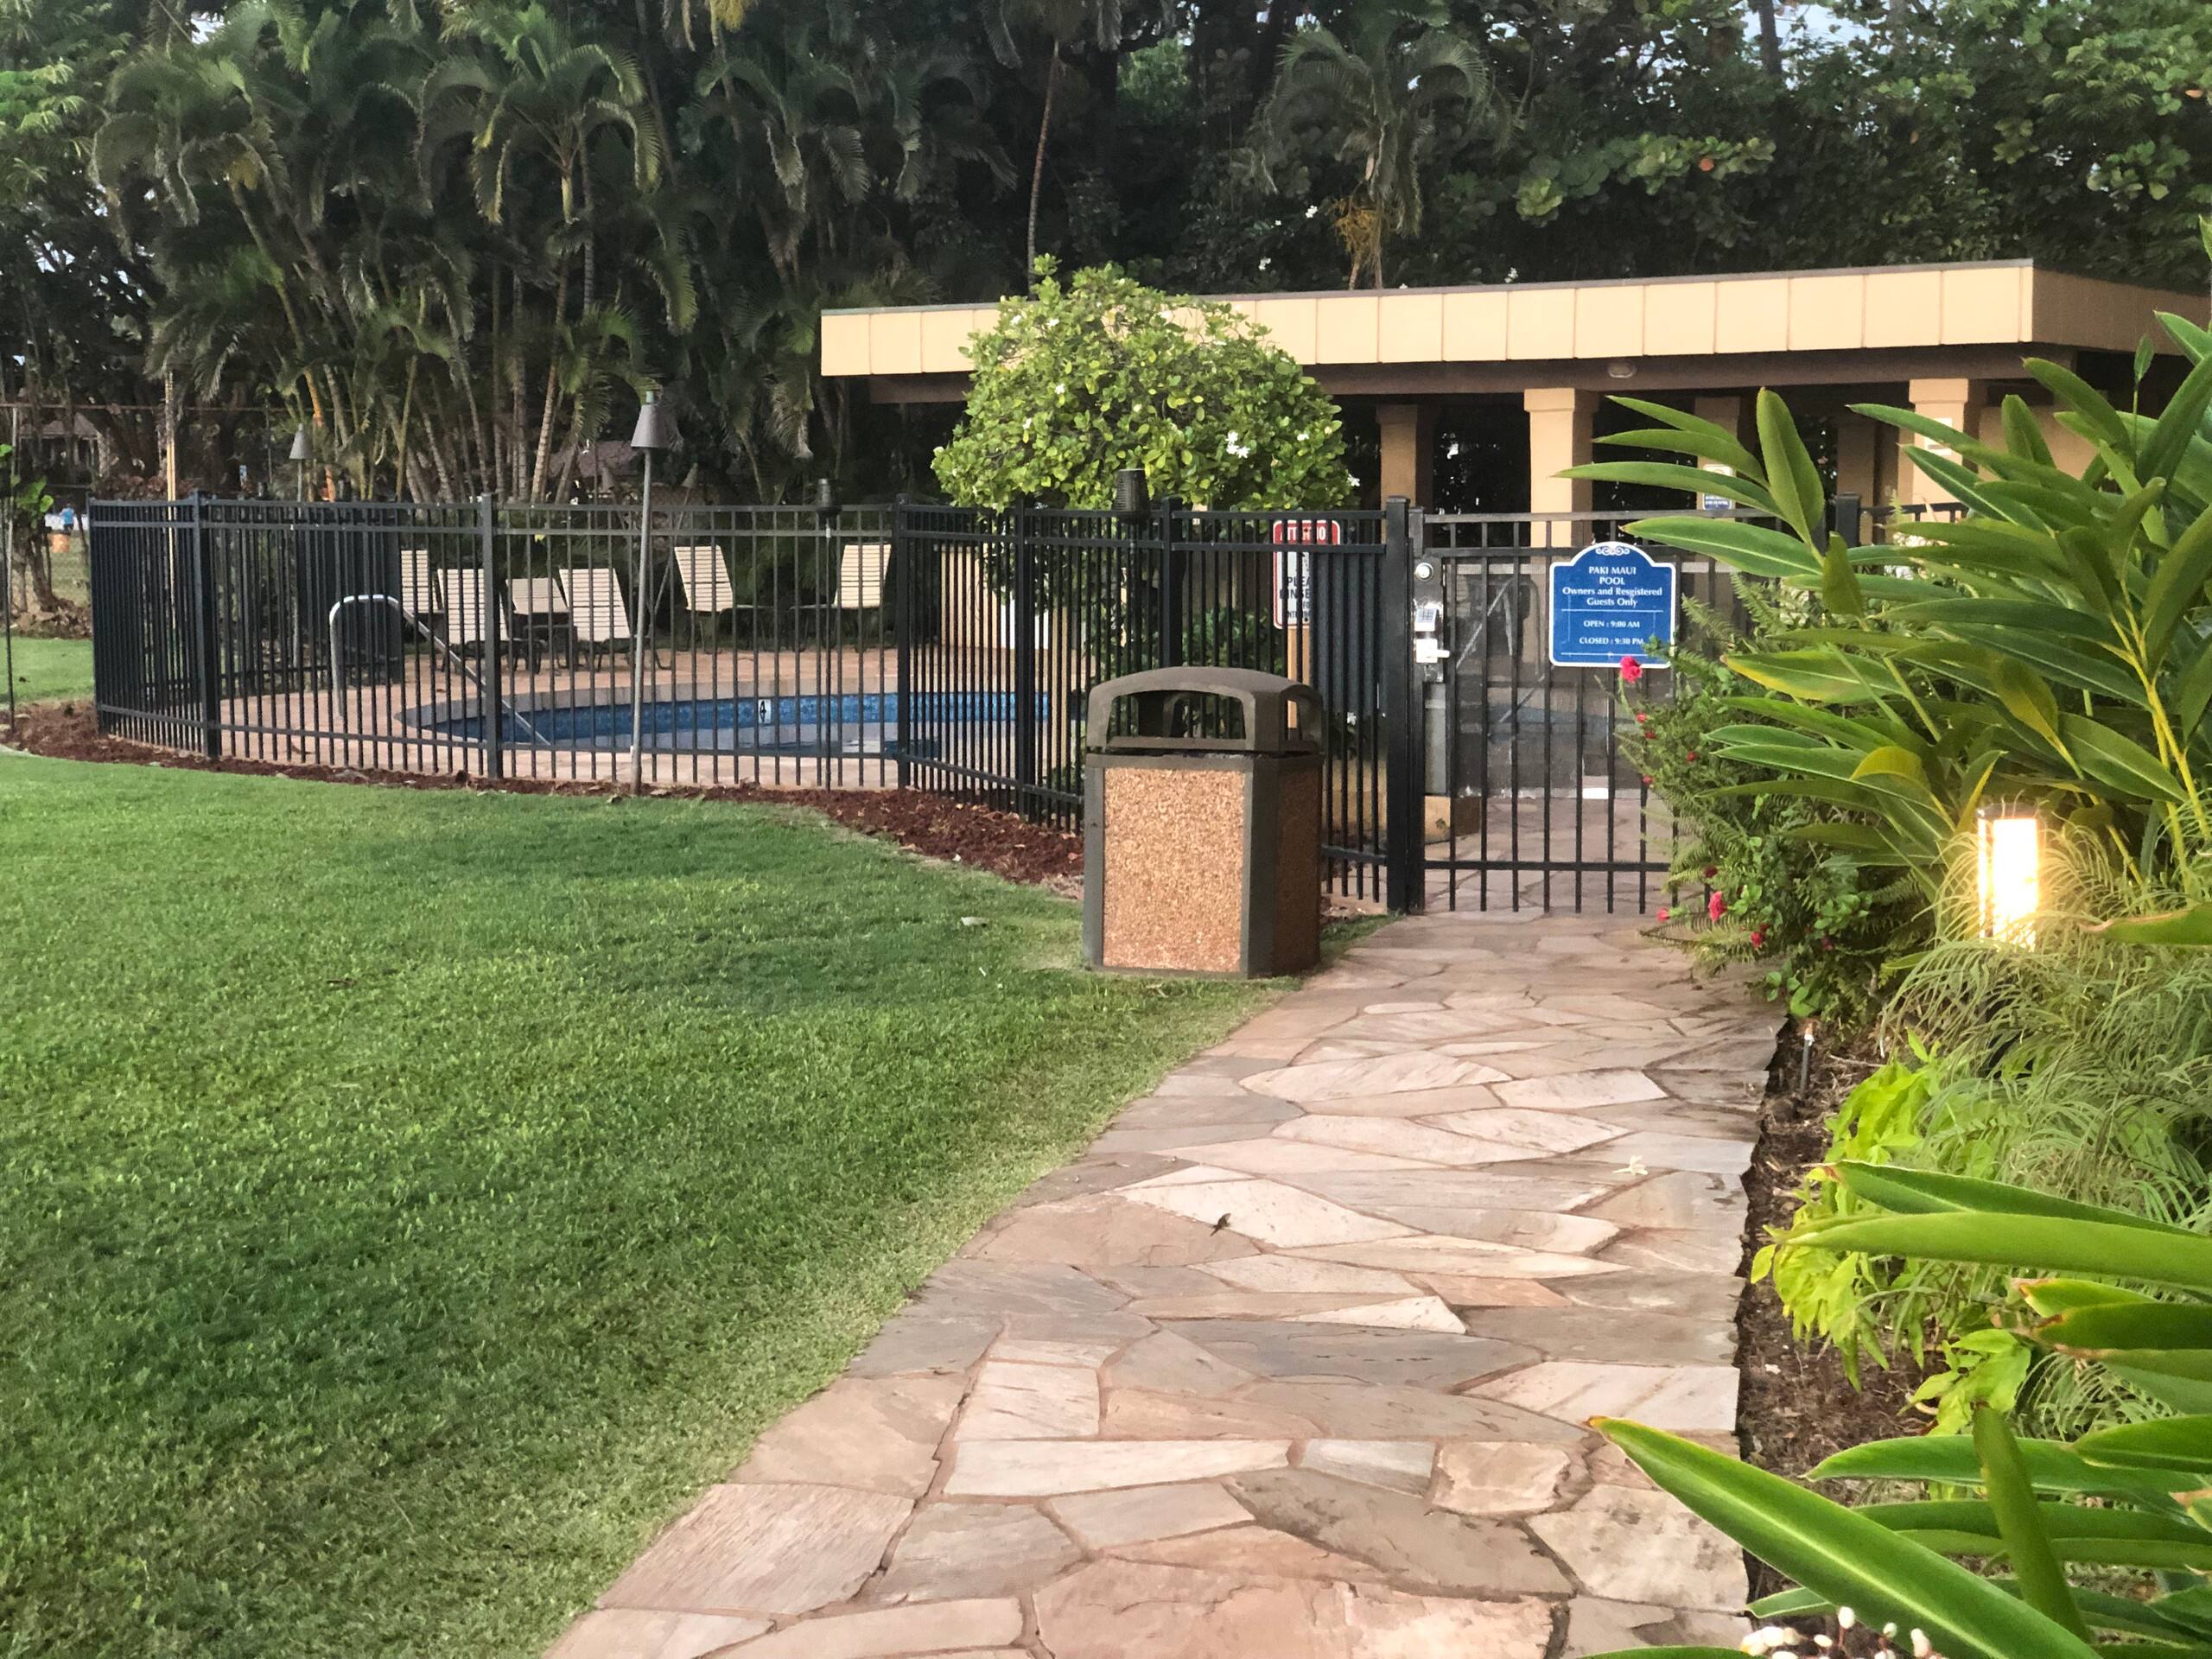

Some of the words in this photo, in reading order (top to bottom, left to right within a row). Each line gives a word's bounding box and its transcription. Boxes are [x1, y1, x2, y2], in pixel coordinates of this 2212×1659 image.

[1588, 566, 1609, 575] PAKI
[1611, 566, 1637, 575] MAUI
[1599, 576, 1625, 585] POOL
[1562, 587, 1595, 595] Owners
[1597, 587, 1613, 595] and
[1615, 587, 1662, 598] Resgistered
[1586, 597, 1615, 606] Guests
[1617, 597, 1638, 608] Only
